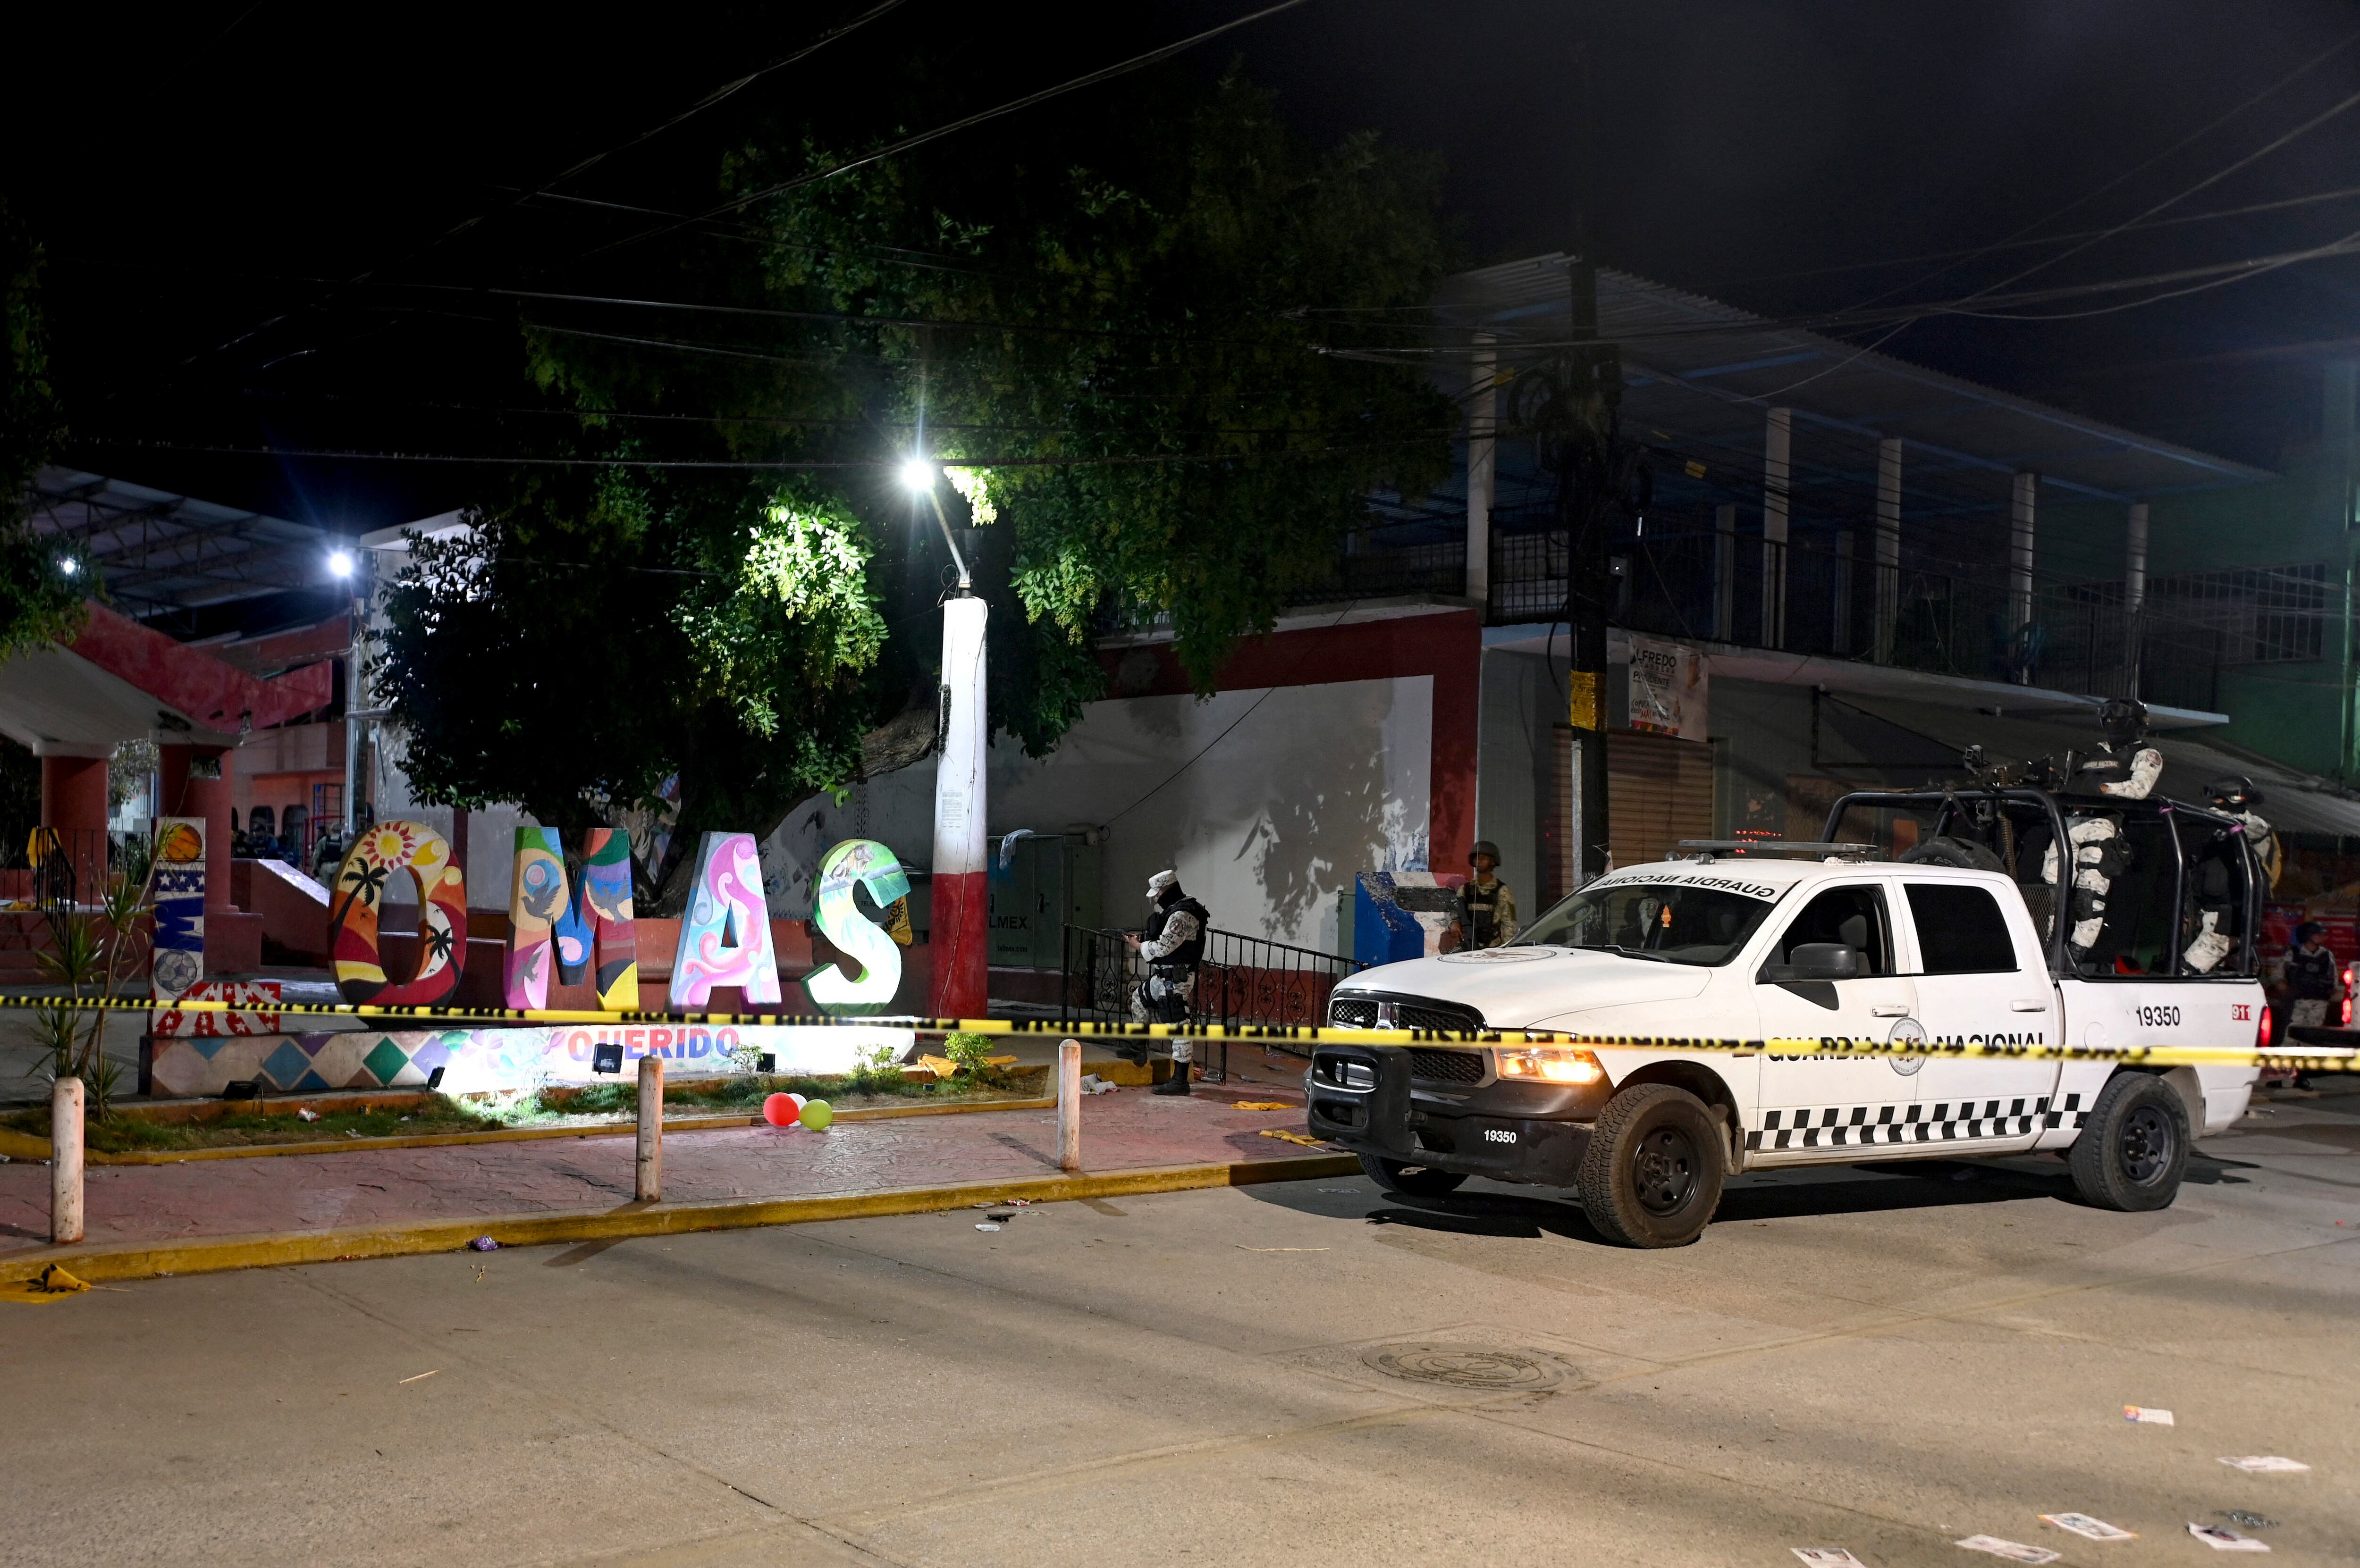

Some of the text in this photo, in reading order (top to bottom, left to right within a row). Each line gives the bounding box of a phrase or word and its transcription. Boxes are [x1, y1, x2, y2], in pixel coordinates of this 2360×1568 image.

[988, 916, 1028, 929] LMEX
[997, 944, 1028, 953] telmex.com
[2136, 1006, 2180, 1026] 19350
[2233, 1005, 2251, 1020] 911
[1484, 1130, 1517, 1144] 19350
